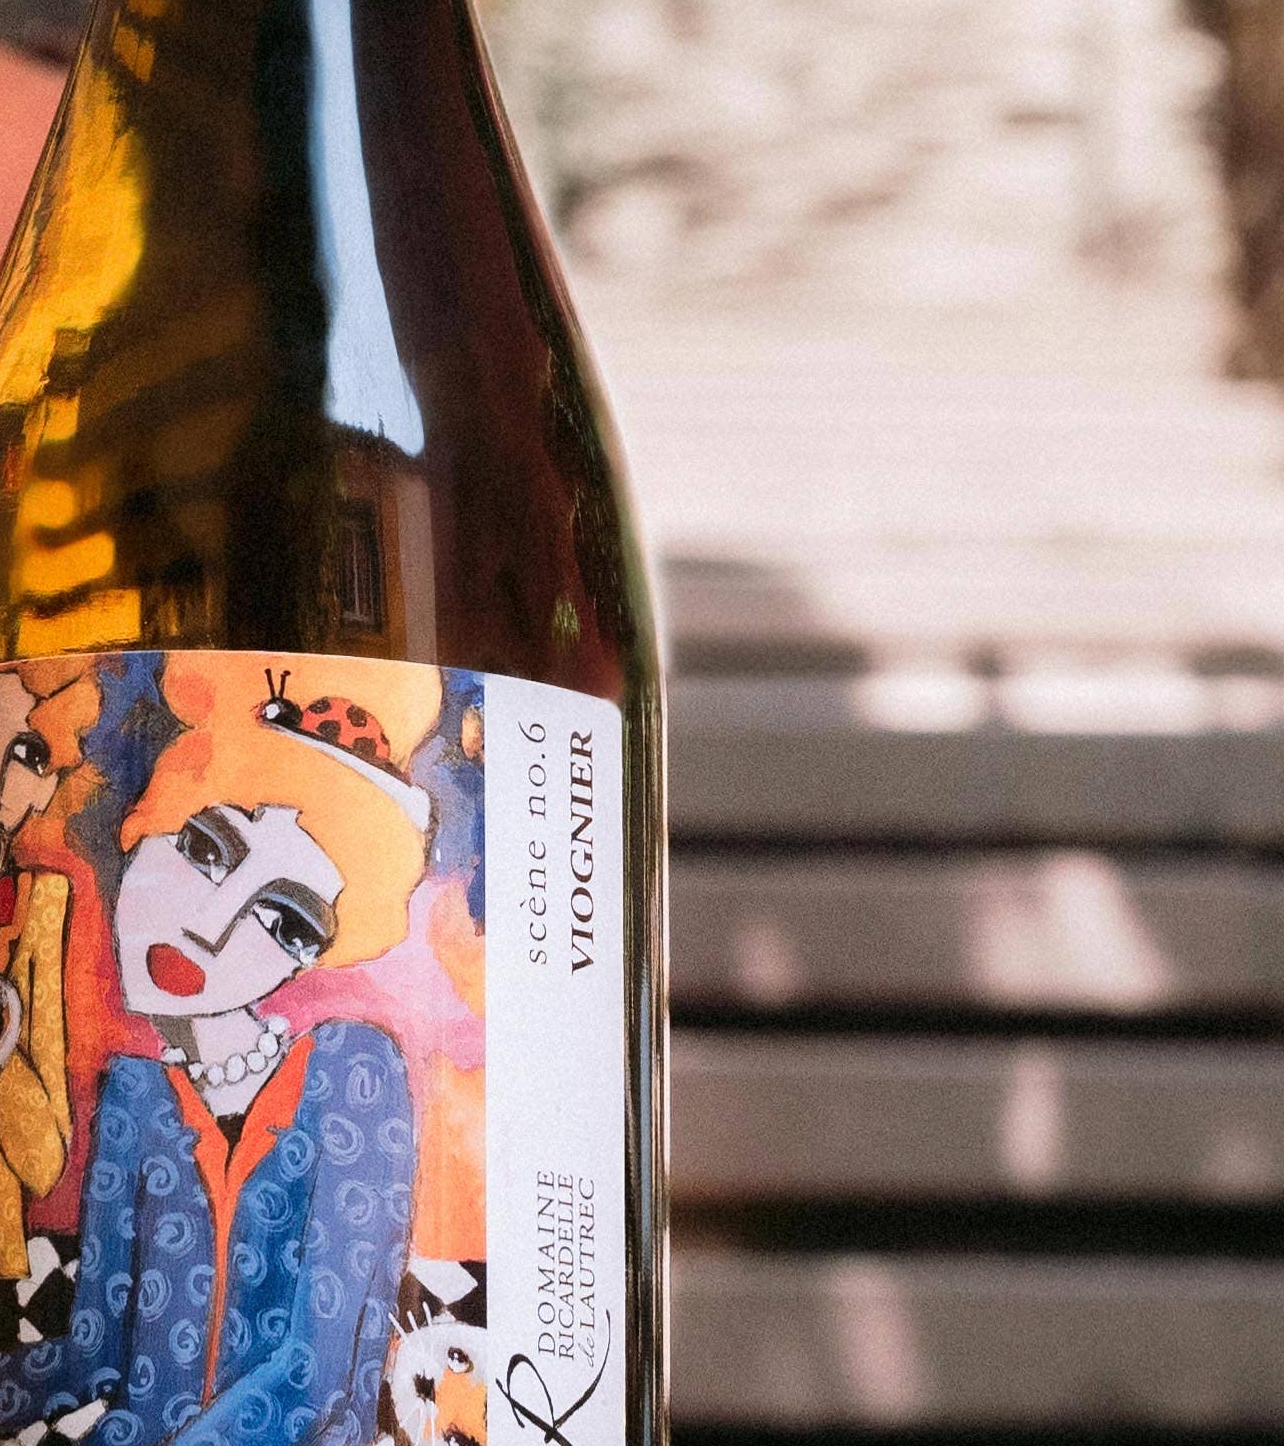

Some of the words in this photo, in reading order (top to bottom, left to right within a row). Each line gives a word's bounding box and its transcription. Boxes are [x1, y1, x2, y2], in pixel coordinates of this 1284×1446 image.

[519, 840, 547, 965] scène
[570, 728, 595, 976] VIOGNIER
[537, 1170, 556, 1356] DOMAINE
[558, 1173, 574, 1360] RICARDELLE
[578, 1177, 595, 1331] LAUTREC
[577, 1334, 596, 1368] de
